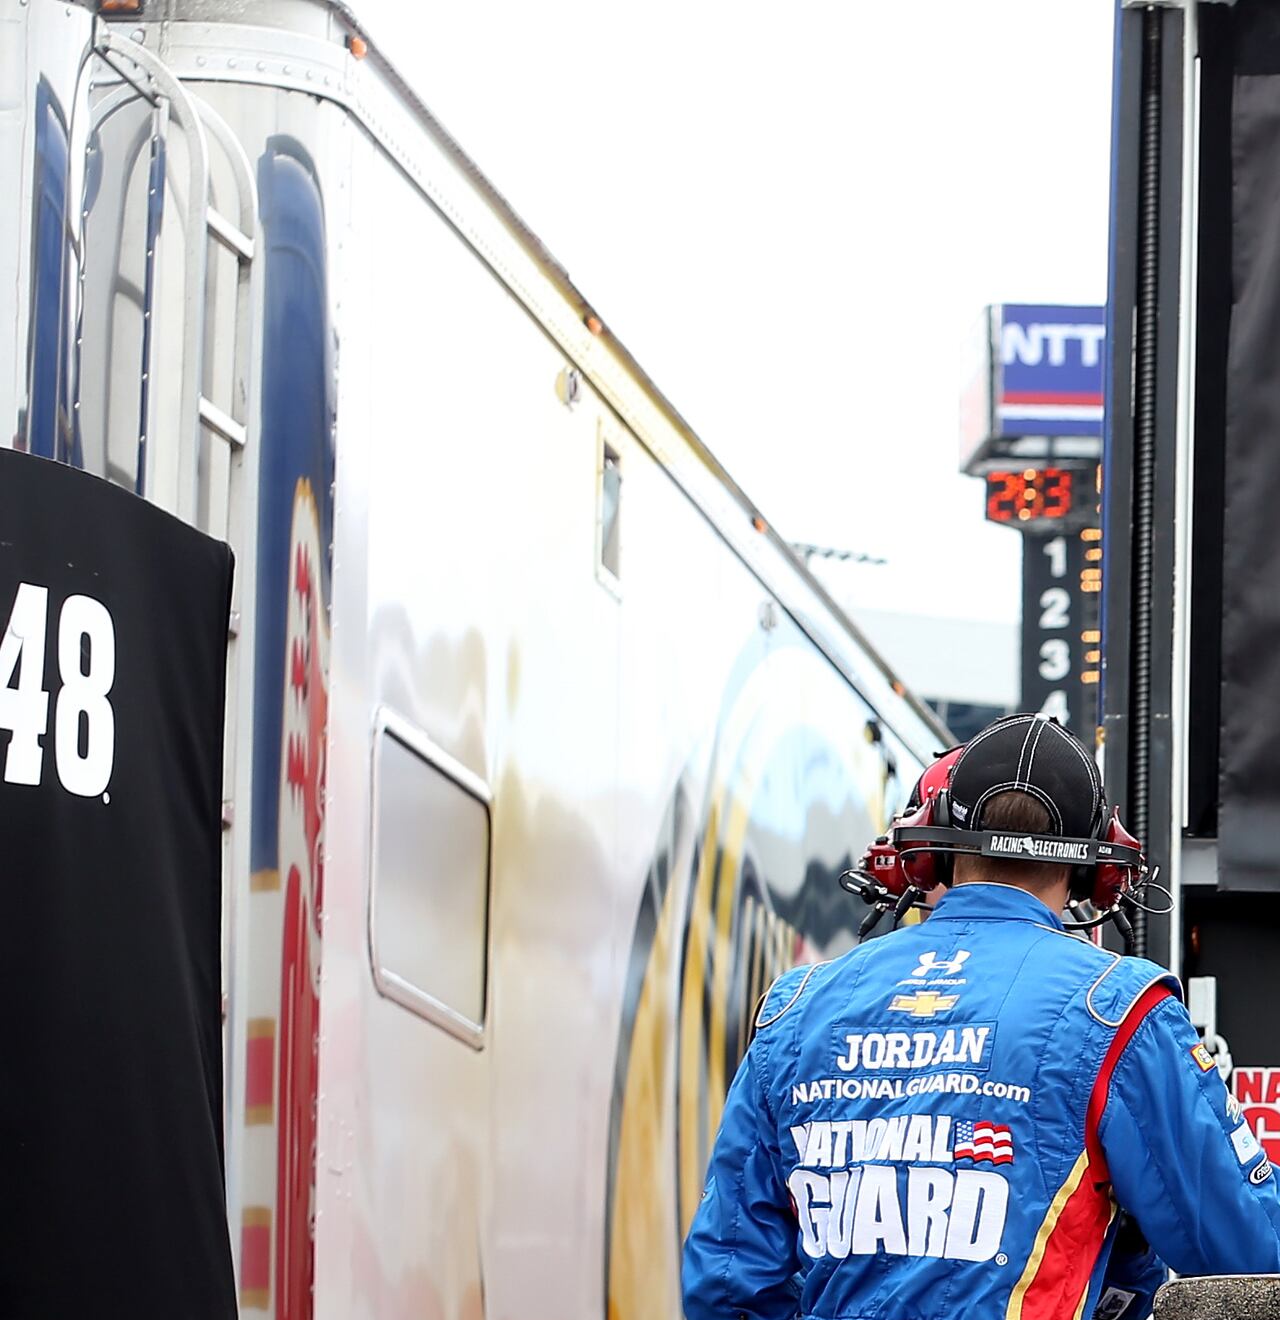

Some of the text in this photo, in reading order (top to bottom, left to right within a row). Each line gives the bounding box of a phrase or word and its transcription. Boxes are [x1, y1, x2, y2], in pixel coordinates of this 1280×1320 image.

[1003, 322, 1106, 366] NTT
[1042, 537, 1067, 578] 1
[1038, 588, 1071, 630] 2
[1038, 639, 1071, 681] 3
[0, 582, 117, 798] 48
[990, 835, 1023, 853] RACING
[1034, 840, 1089, 860] ELECTRONICS
[836, 1027, 990, 1072] JORDAN
[791, 1073, 1032, 1105] NATIONALGUARD.com
[790, 1114, 954, 1167] NATIONAL
[787, 1164, 1010, 1263] GUARD
